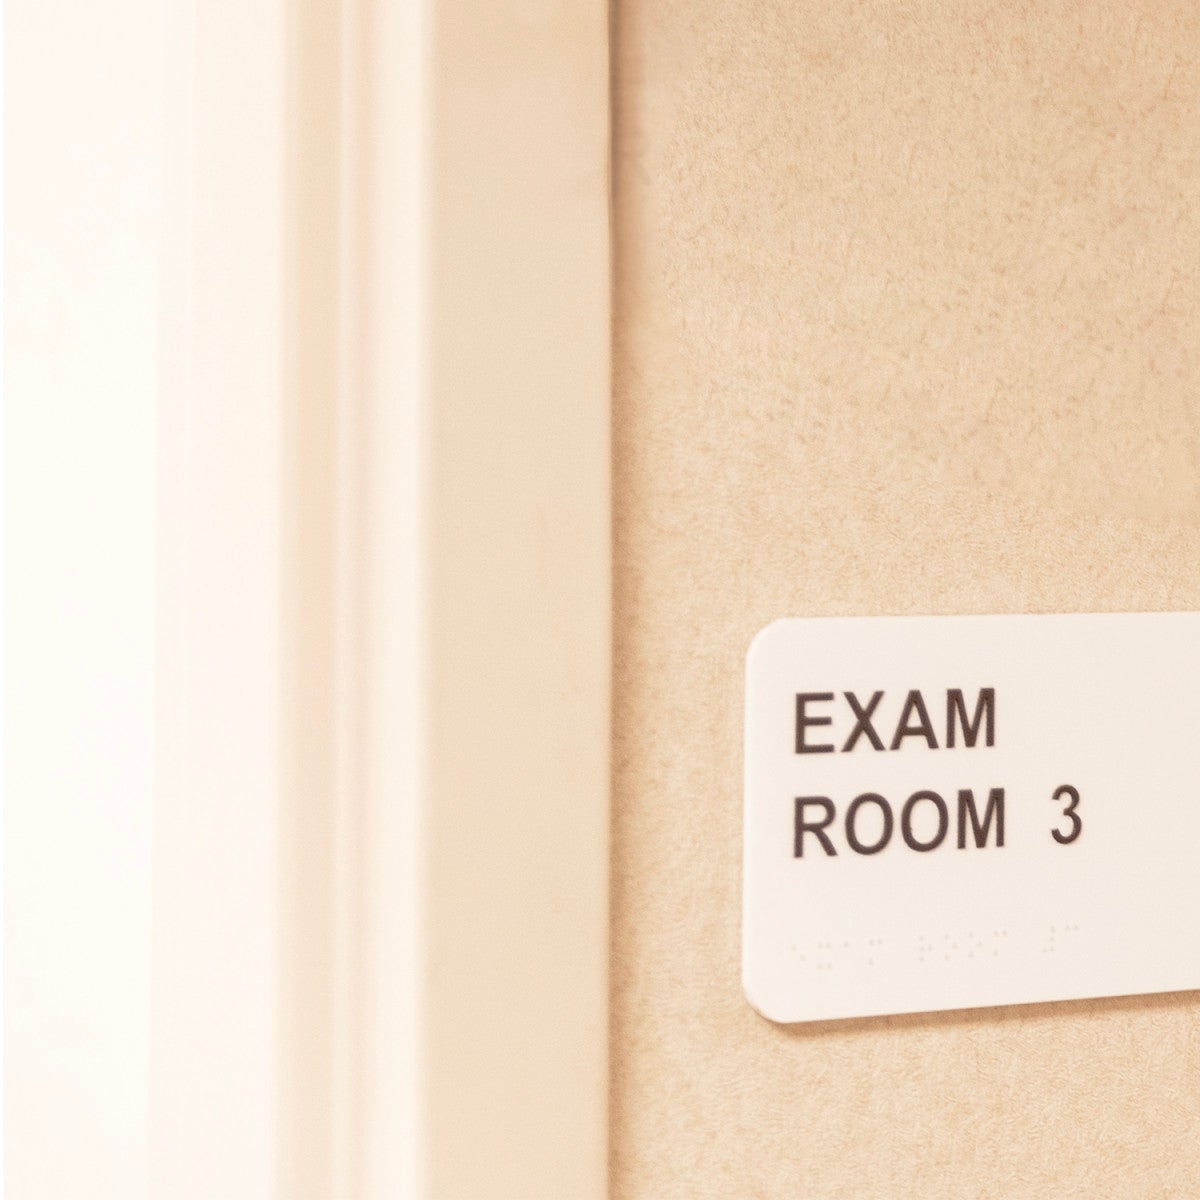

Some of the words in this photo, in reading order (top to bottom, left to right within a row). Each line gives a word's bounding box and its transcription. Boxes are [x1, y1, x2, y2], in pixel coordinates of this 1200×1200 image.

[795, 688, 995, 754] EXAM
[794, 788, 1005, 858] ROOM
[1051, 785, 1082, 845] 3
